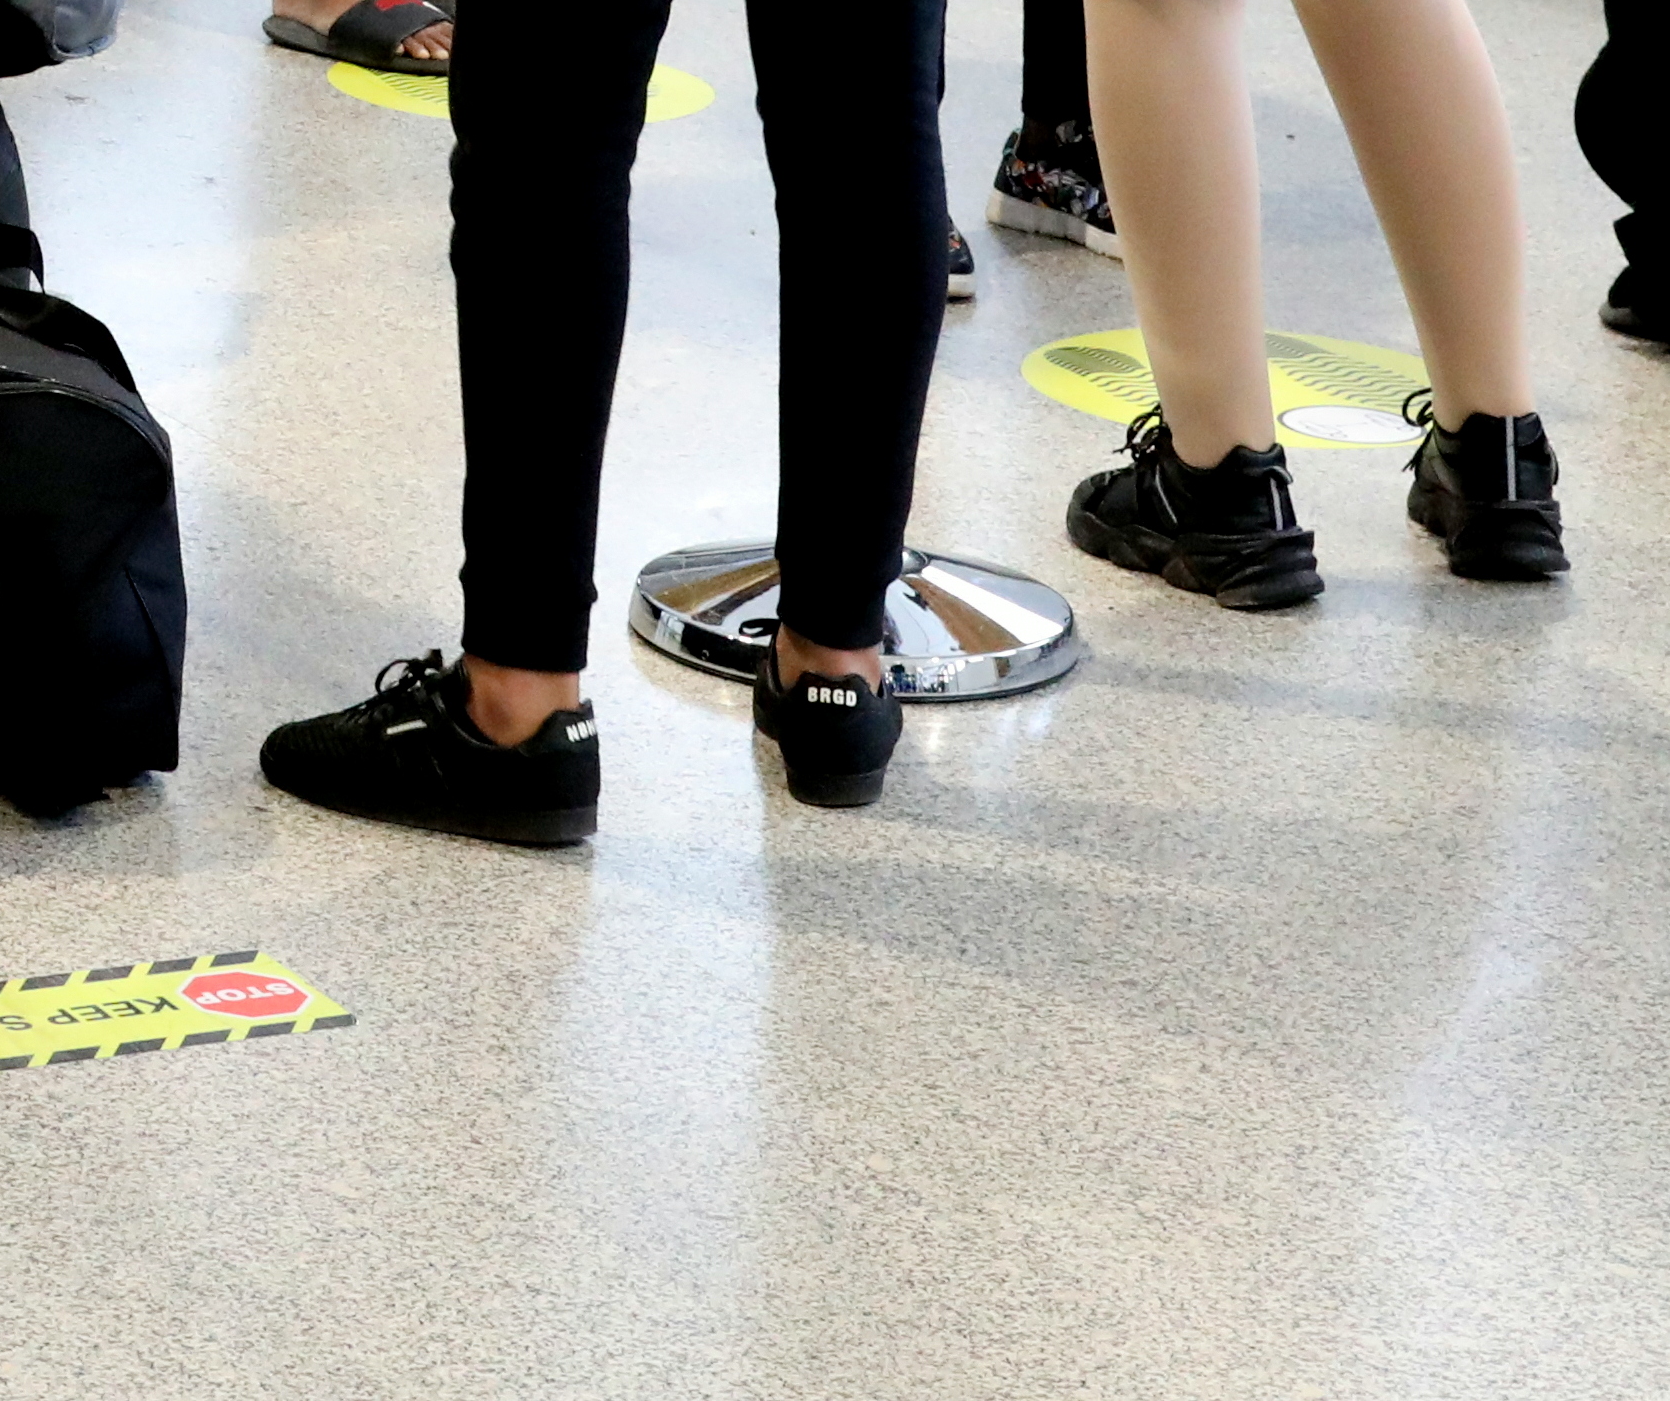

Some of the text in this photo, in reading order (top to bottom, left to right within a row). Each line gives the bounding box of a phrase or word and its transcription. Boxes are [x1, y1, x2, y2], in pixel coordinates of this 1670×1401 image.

[807, 686, 858, 708] BRGD
[195, 982, 296, 1006] STOP
[48, 996, 179, 1025] KEEP
